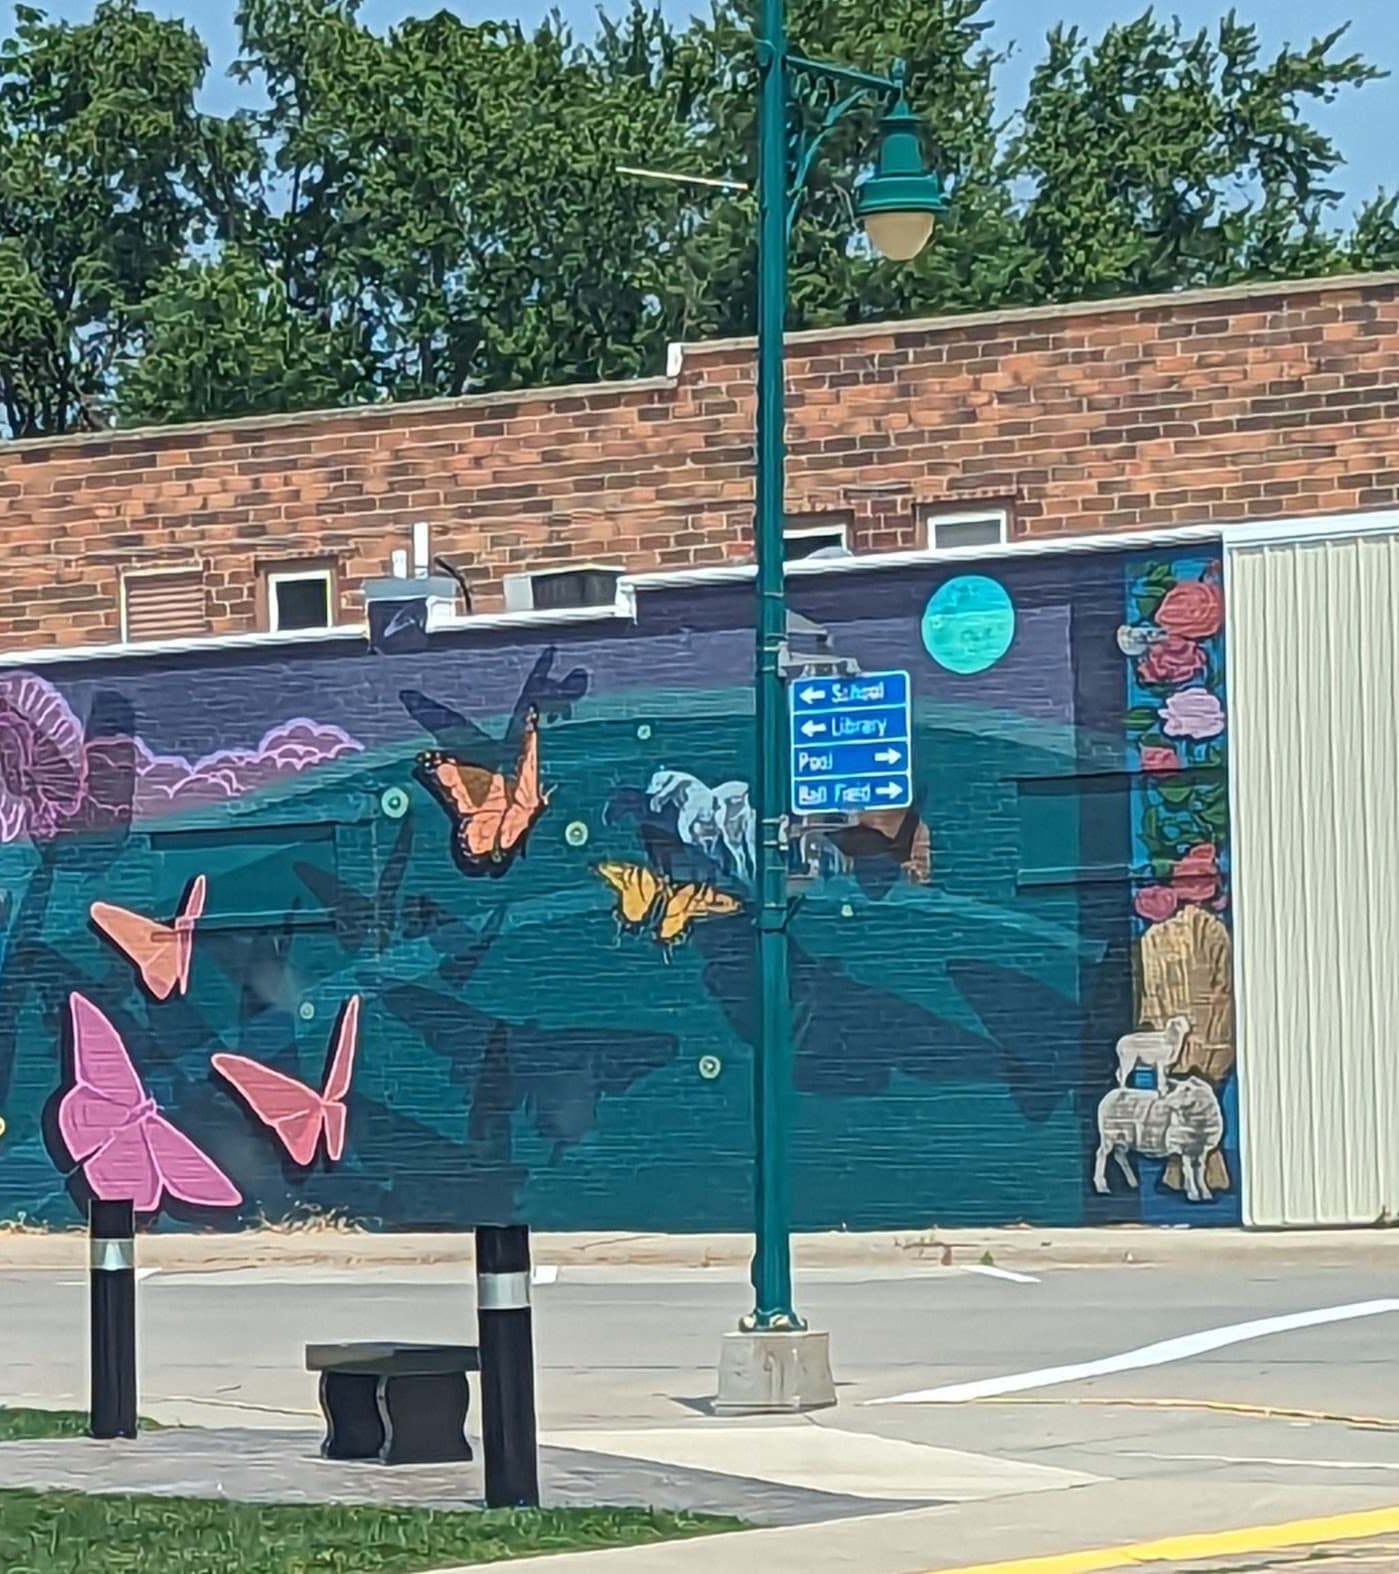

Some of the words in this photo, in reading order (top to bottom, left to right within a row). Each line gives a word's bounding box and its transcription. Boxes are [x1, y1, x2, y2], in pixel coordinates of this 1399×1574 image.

[831, 682, 884, 702] School
[831, 717, 887, 736] Library
[799, 752, 833, 772] Pool
